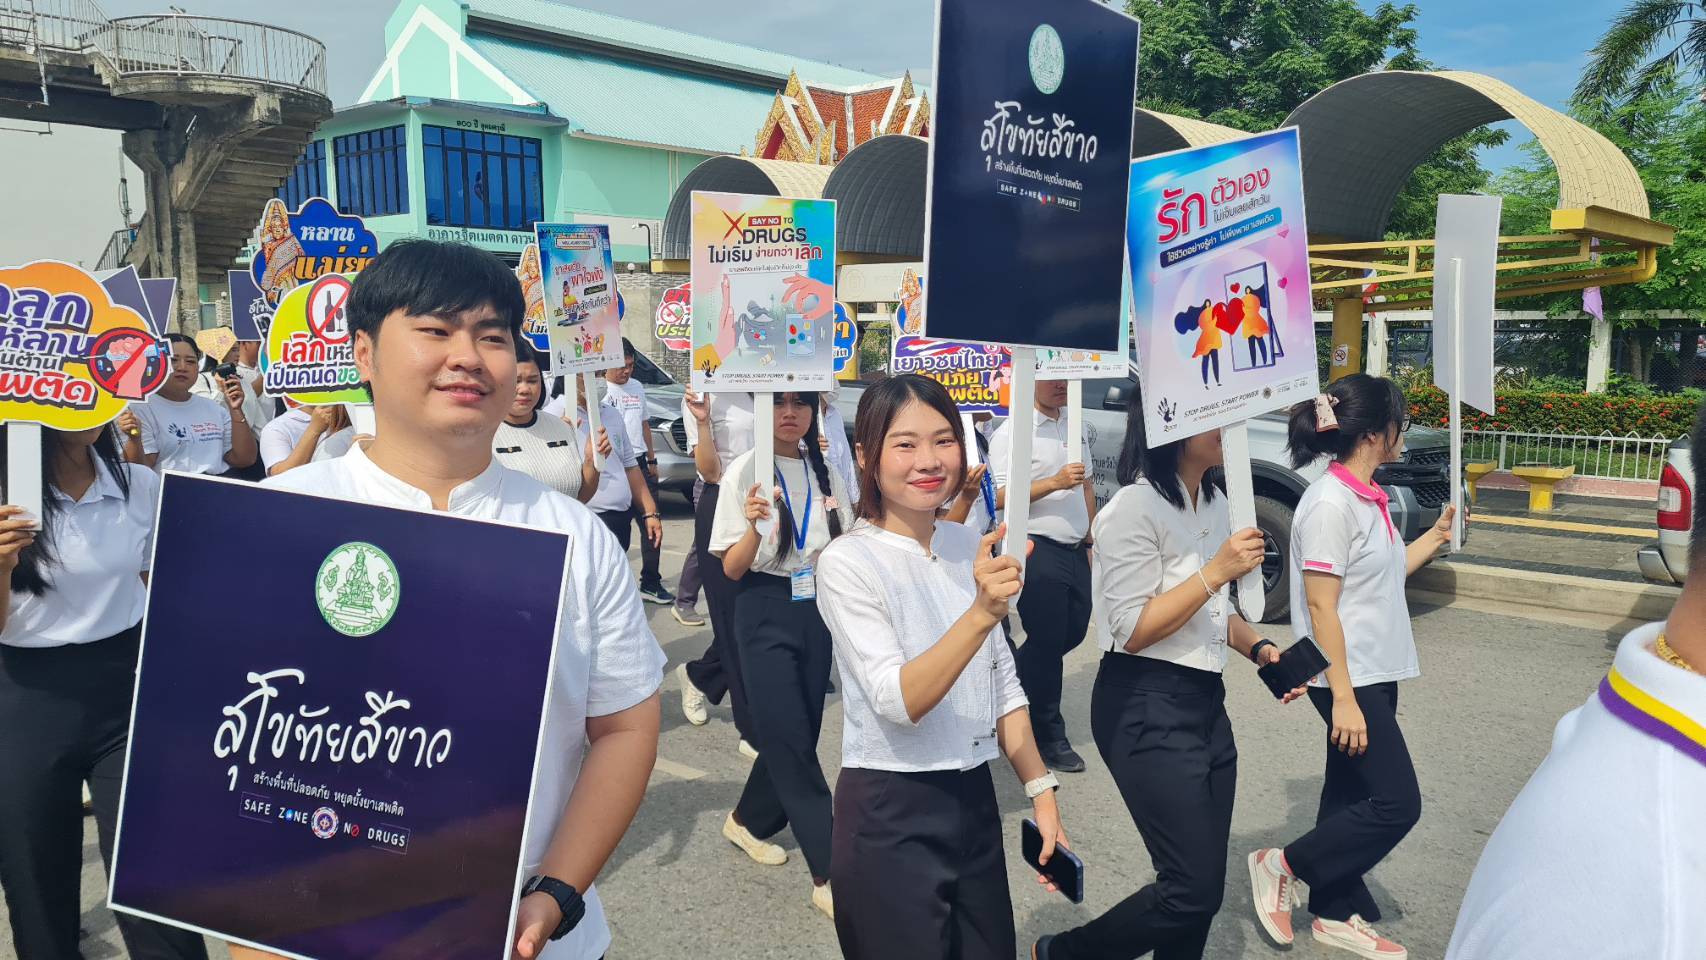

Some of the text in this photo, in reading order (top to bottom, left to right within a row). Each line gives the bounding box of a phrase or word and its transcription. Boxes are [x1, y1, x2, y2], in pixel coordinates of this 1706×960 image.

[980, 101, 1098, 172] สุโขทัยสีขาว
[1000, 184, 1017, 194] SAFE
[1157, 167, 1271, 243] รัก ตัวเอง
[751, 217, 764, 225] SAY
[765, 217, 780, 225] NO
[300, 226, 355, 242] หลาน
[742, 228, 807, 244] DRUGS
[708, 242, 822, 263] ไม่เริ่ม ง่ายกว่า เลิก
[895, 349, 1002, 370] เยาวชนไทย
[213, 668, 452, 791] สุโขทัยสีขาว
[253, 770, 404, 817] สร้างพื้นที่ปลอดภัย หยุดยั้งยาเสพติด
[244, 799, 271, 815] SAFE
[367, 828, 406, 847] DRUGS
